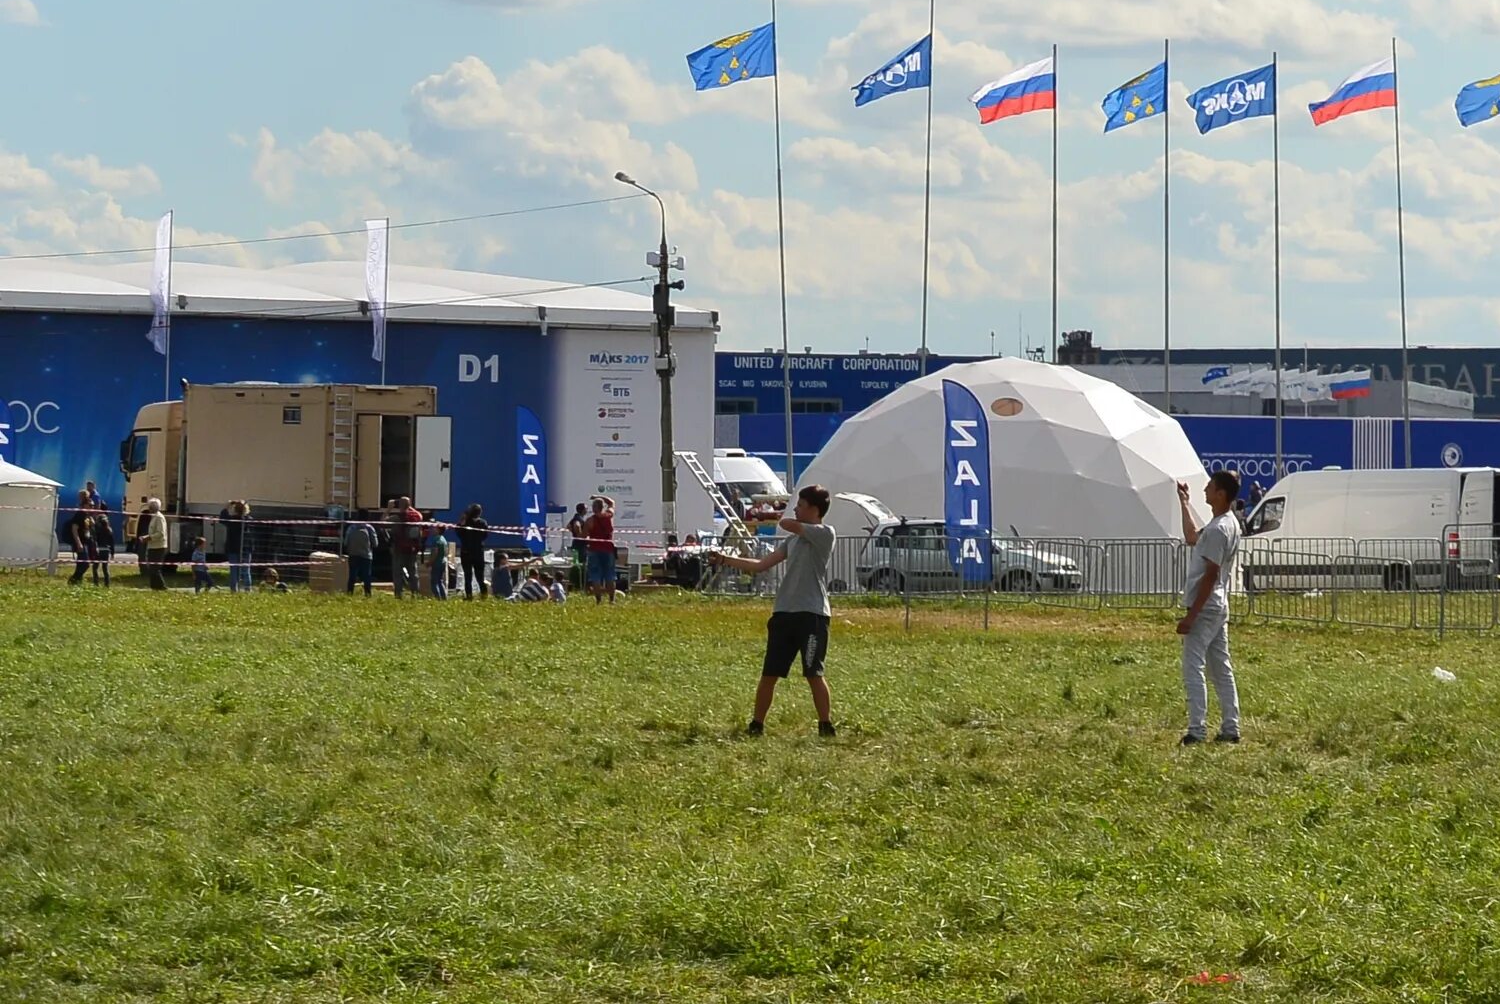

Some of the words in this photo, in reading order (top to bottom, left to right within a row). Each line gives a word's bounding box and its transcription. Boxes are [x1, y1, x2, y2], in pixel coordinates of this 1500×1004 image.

[590, 352, 623, 366] MAKS
[624, 356, 649, 364] 2017
[734, 356, 774, 369] UNITED
[842, 358, 919, 372] CORPORATION
[458, 353, 500, 383] D1
[761, 380, 793, 389] YAKOVLV
